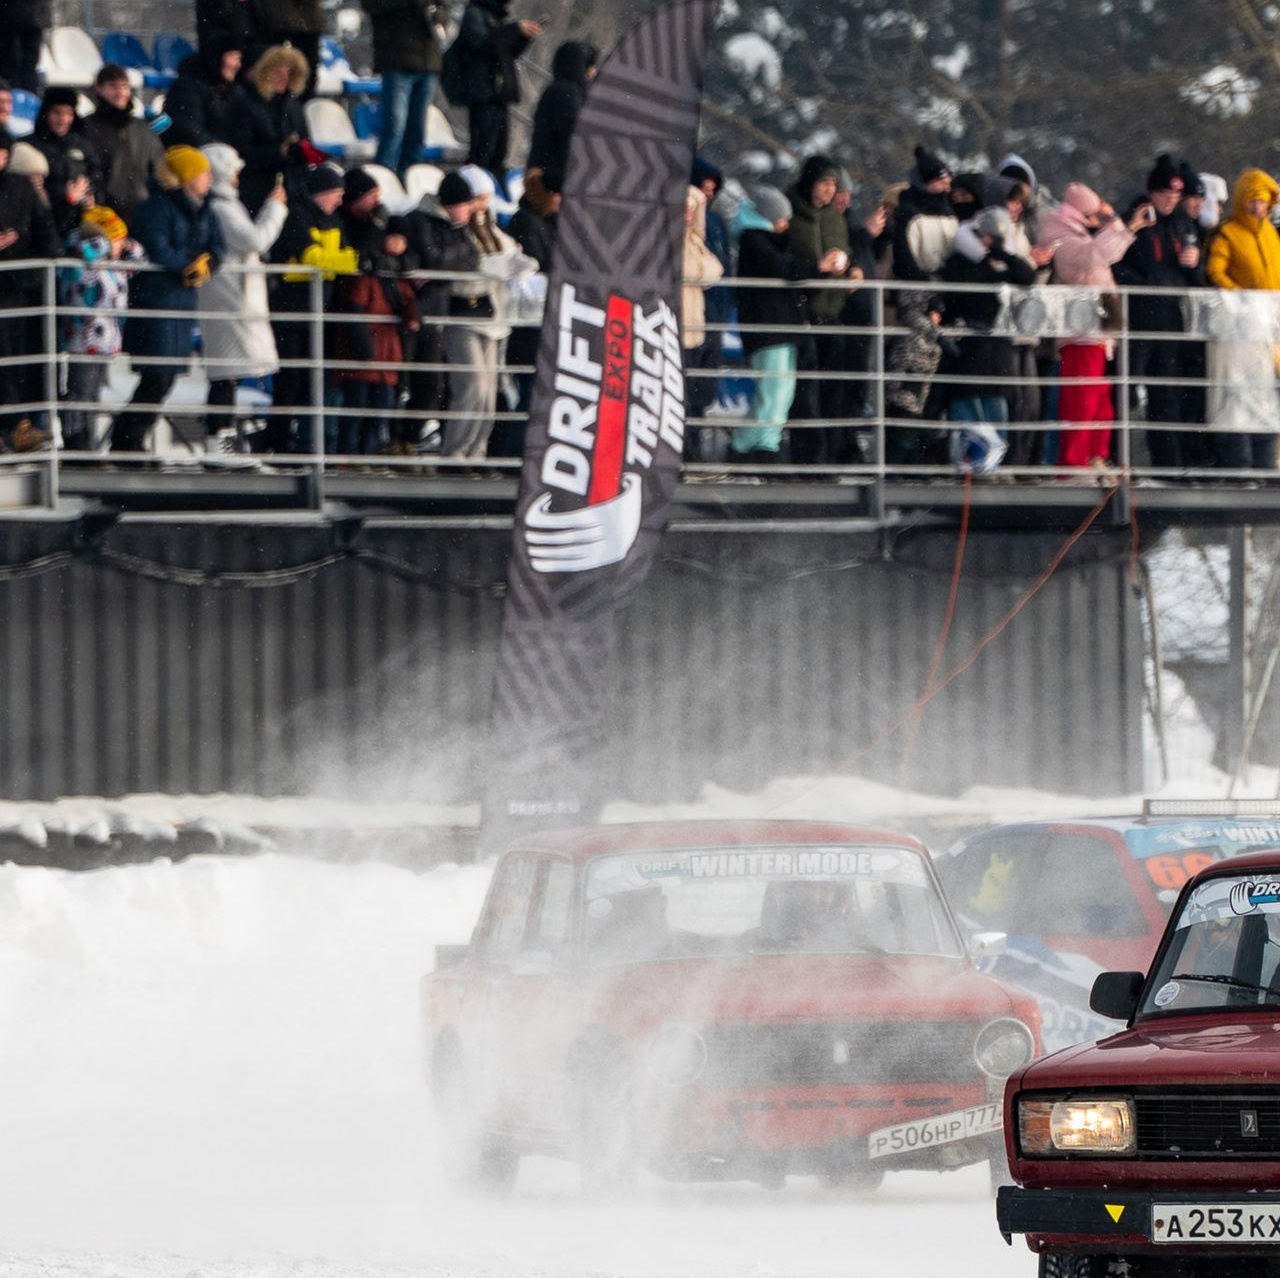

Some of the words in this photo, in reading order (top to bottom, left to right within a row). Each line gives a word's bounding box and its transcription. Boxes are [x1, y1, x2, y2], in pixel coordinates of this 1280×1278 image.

[541, 282, 607, 496] DRIFT
[605, 318, 627, 401] EXPO
[626, 302, 665, 469] TRACK
[658, 298, 685, 453] MODE
[640, 860, 690, 873] DRIFT
[690, 853, 793, 878] WINTER
[798, 852, 872, 876] MODE
[966, 1104, 998, 1127] 777
